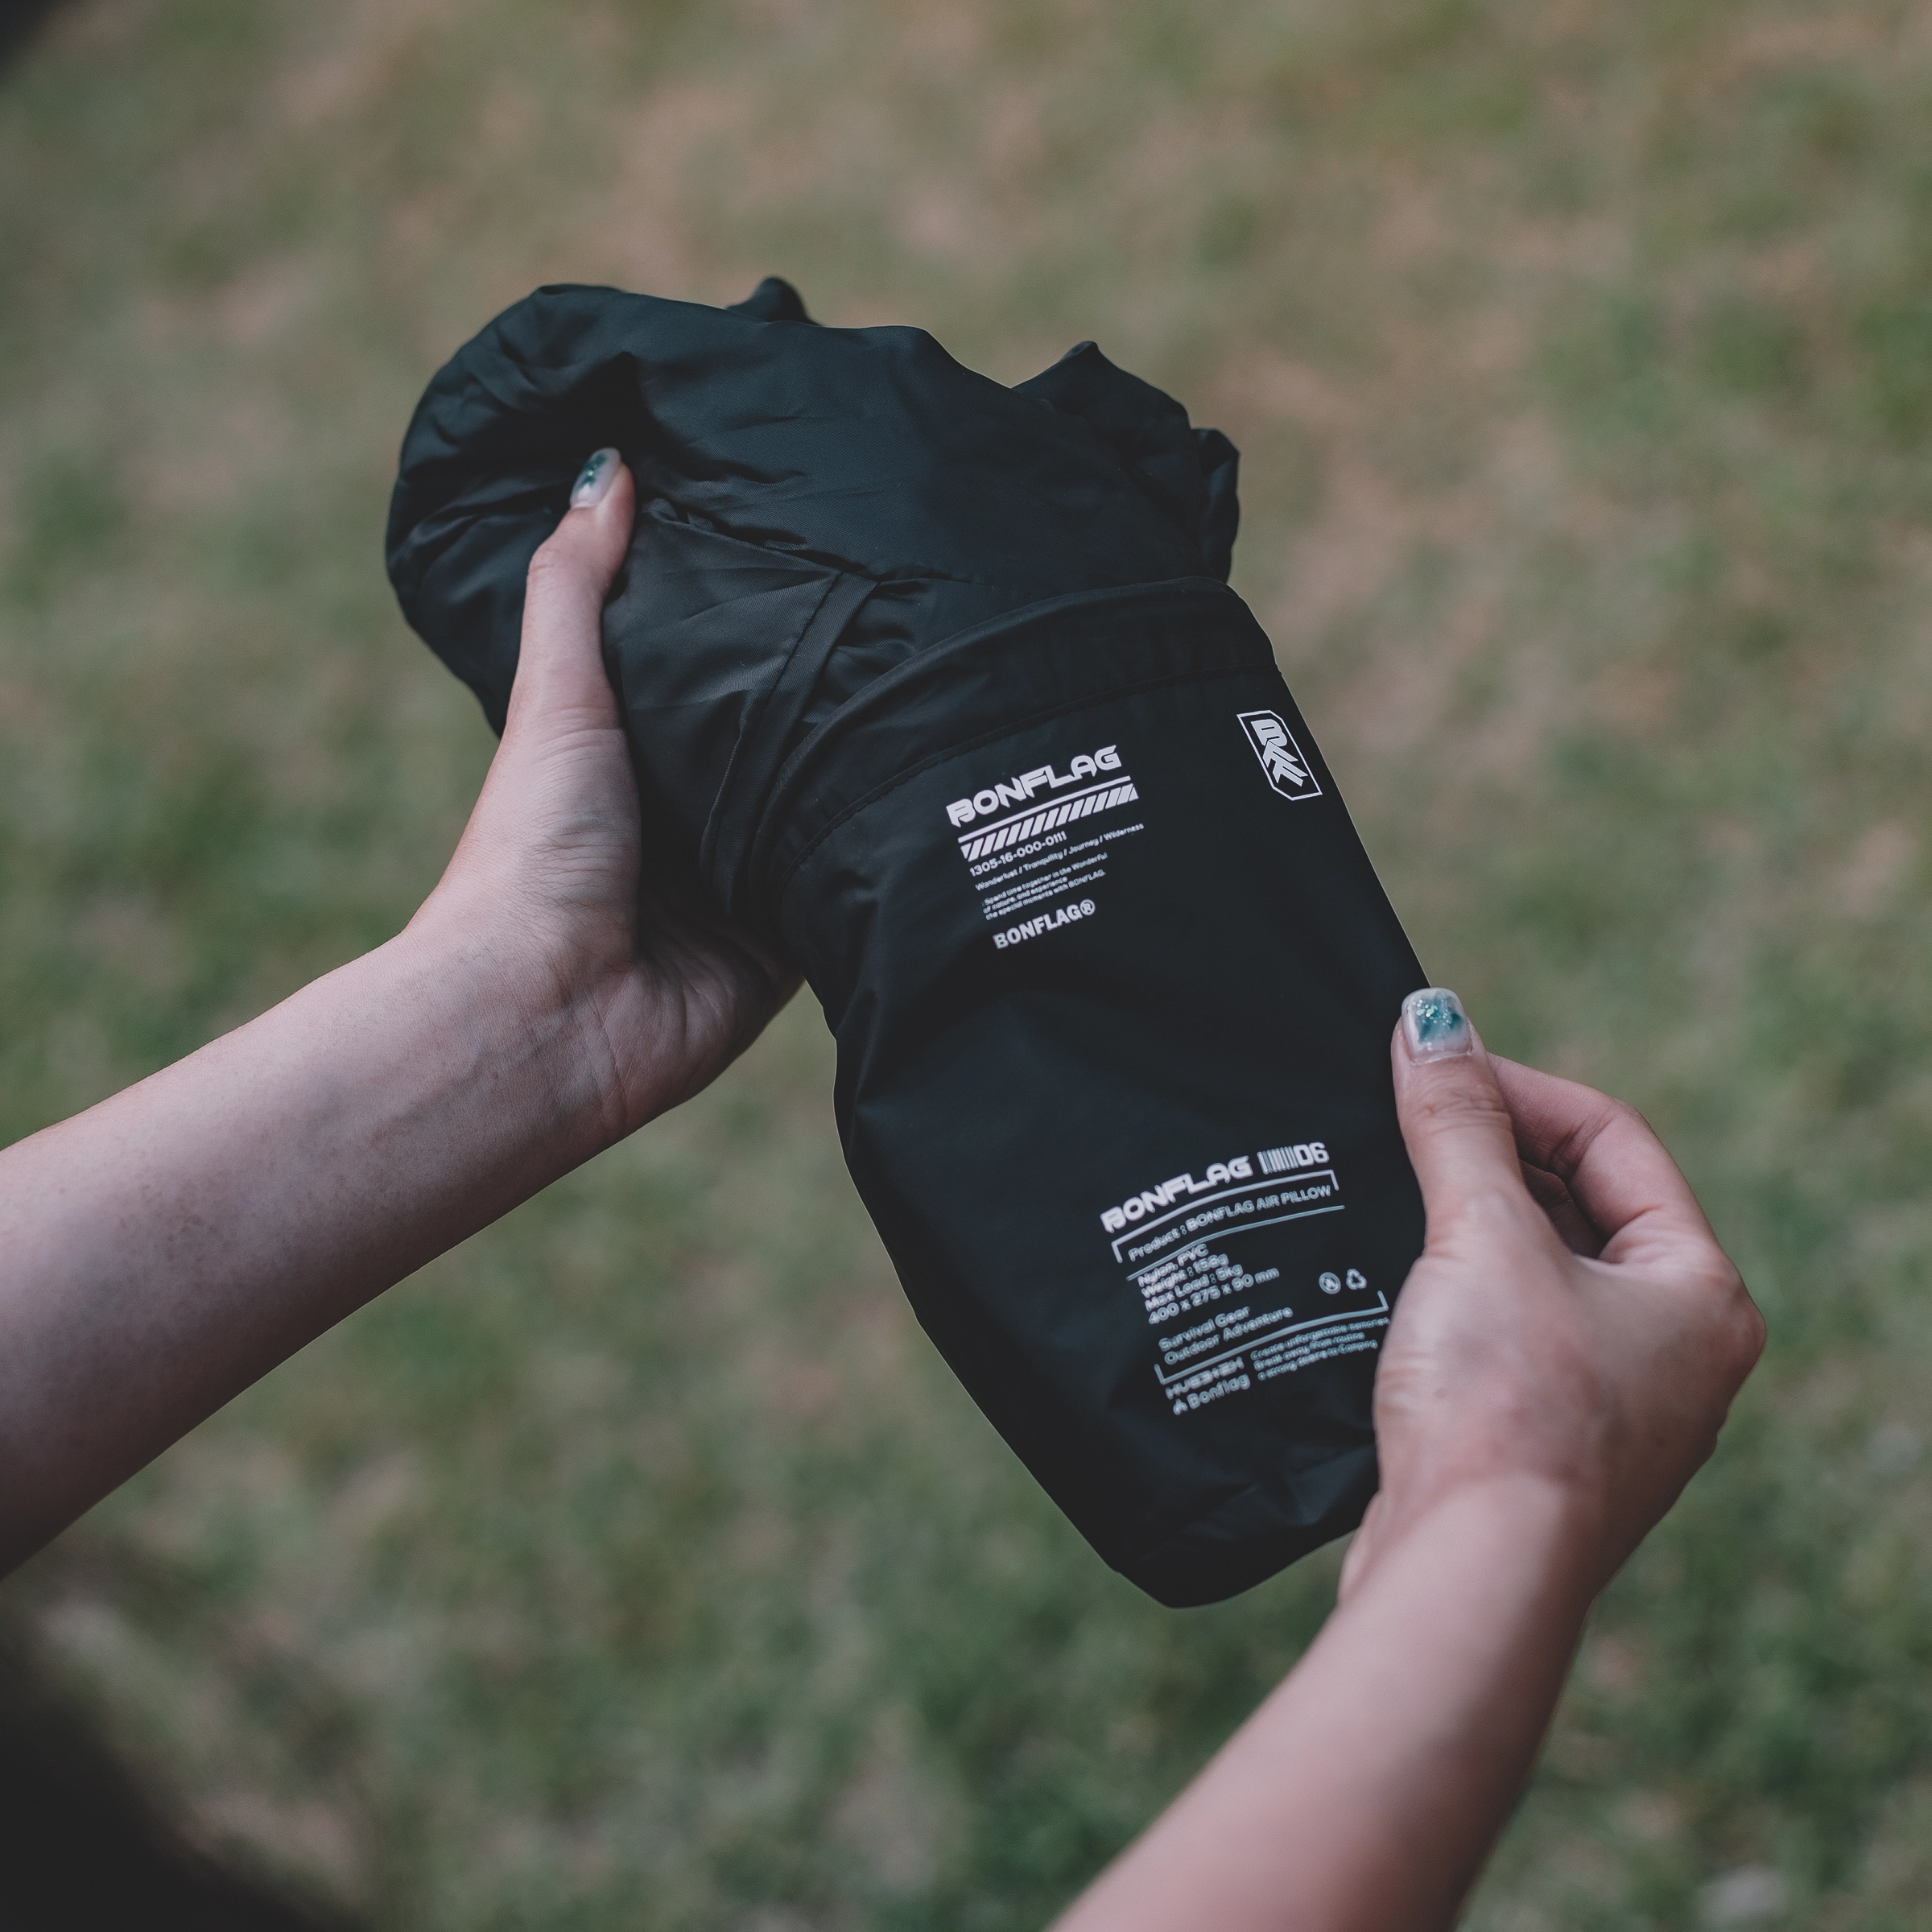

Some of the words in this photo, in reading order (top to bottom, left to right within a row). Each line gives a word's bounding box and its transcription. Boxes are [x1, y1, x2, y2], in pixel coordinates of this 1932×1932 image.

[946, 745, 1122, 827] BONFLAG
[970, 831, 1067, 877] 1305-16-000-0111
[975, 870, 1018, 891] Wanderlust
[1023, 852, 1063, 872] Tranquility
[1069, 838, 1099, 854] Journey
[1103, 823, 1144, 841] Wilderness
[1100, 1155, 1253, 1233] BONFLAG
[1128, 1228, 1181, 1261] Product
[1185, 1199, 1255, 1232] BONFLAG
[1256, 1195, 1280, 1210] AIR
[1280, 1185, 1331, 1204] PILLOW
[1177, 1243, 1208, 1266] PVC
[1141, 1269, 1188, 1298] Weight
[1145, 1291, 1175, 1312] Max
[1174, 1274, 1210, 1298] Load
[1216, 1264, 1244, 1281] 5kg
[1149, 1302, 1179, 1324] 400
[1191, 1285, 1221, 1307] 275
[1231, 1274, 1254, 1291] 90
[1255, 1267, 1280, 1284] mm
[1158, 1319, 1216, 1352] Survival
[1215, 1306, 1250, 1327] Gear
[1164, 1334, 1220, 1364] Outdoor
[1223, 1307, 1293, 1341] Adventure
[1187, 1373, 1251, 1410] Bonflag
